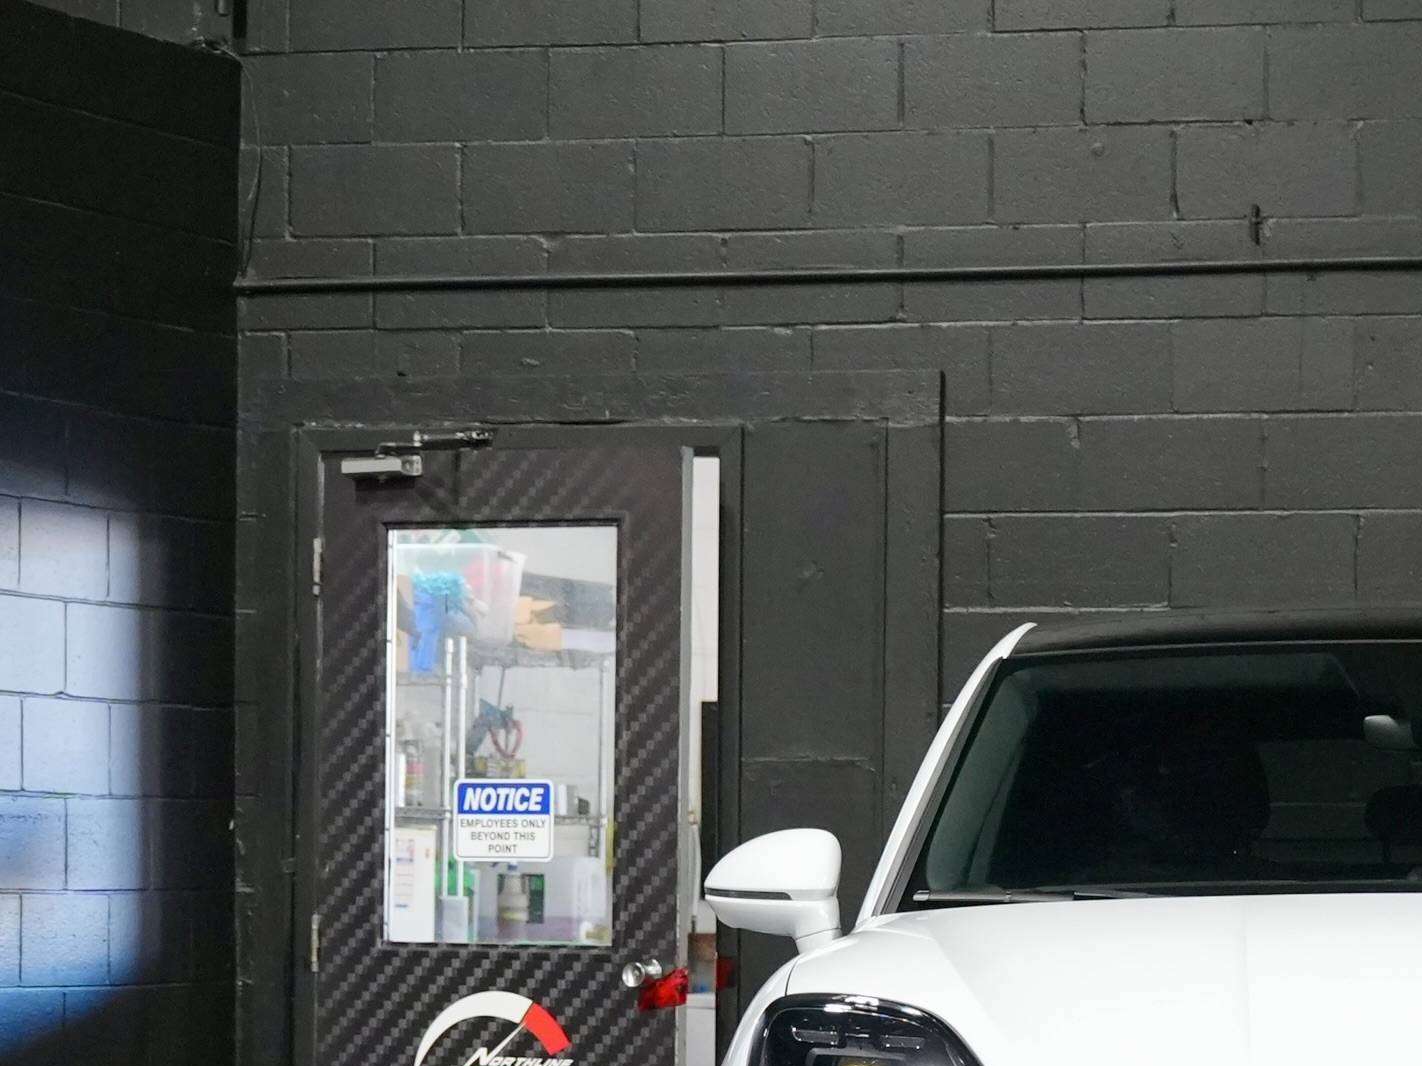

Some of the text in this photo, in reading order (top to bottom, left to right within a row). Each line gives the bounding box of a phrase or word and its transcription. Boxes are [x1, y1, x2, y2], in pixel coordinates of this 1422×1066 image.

[463, 787, 545, 812] NOTICE
[460, 818, 546, 828] EMPLOYEES ONLY
[470, 831, 536, 841] BEYOND THIS
[488, 844, 518, 854] POINT
